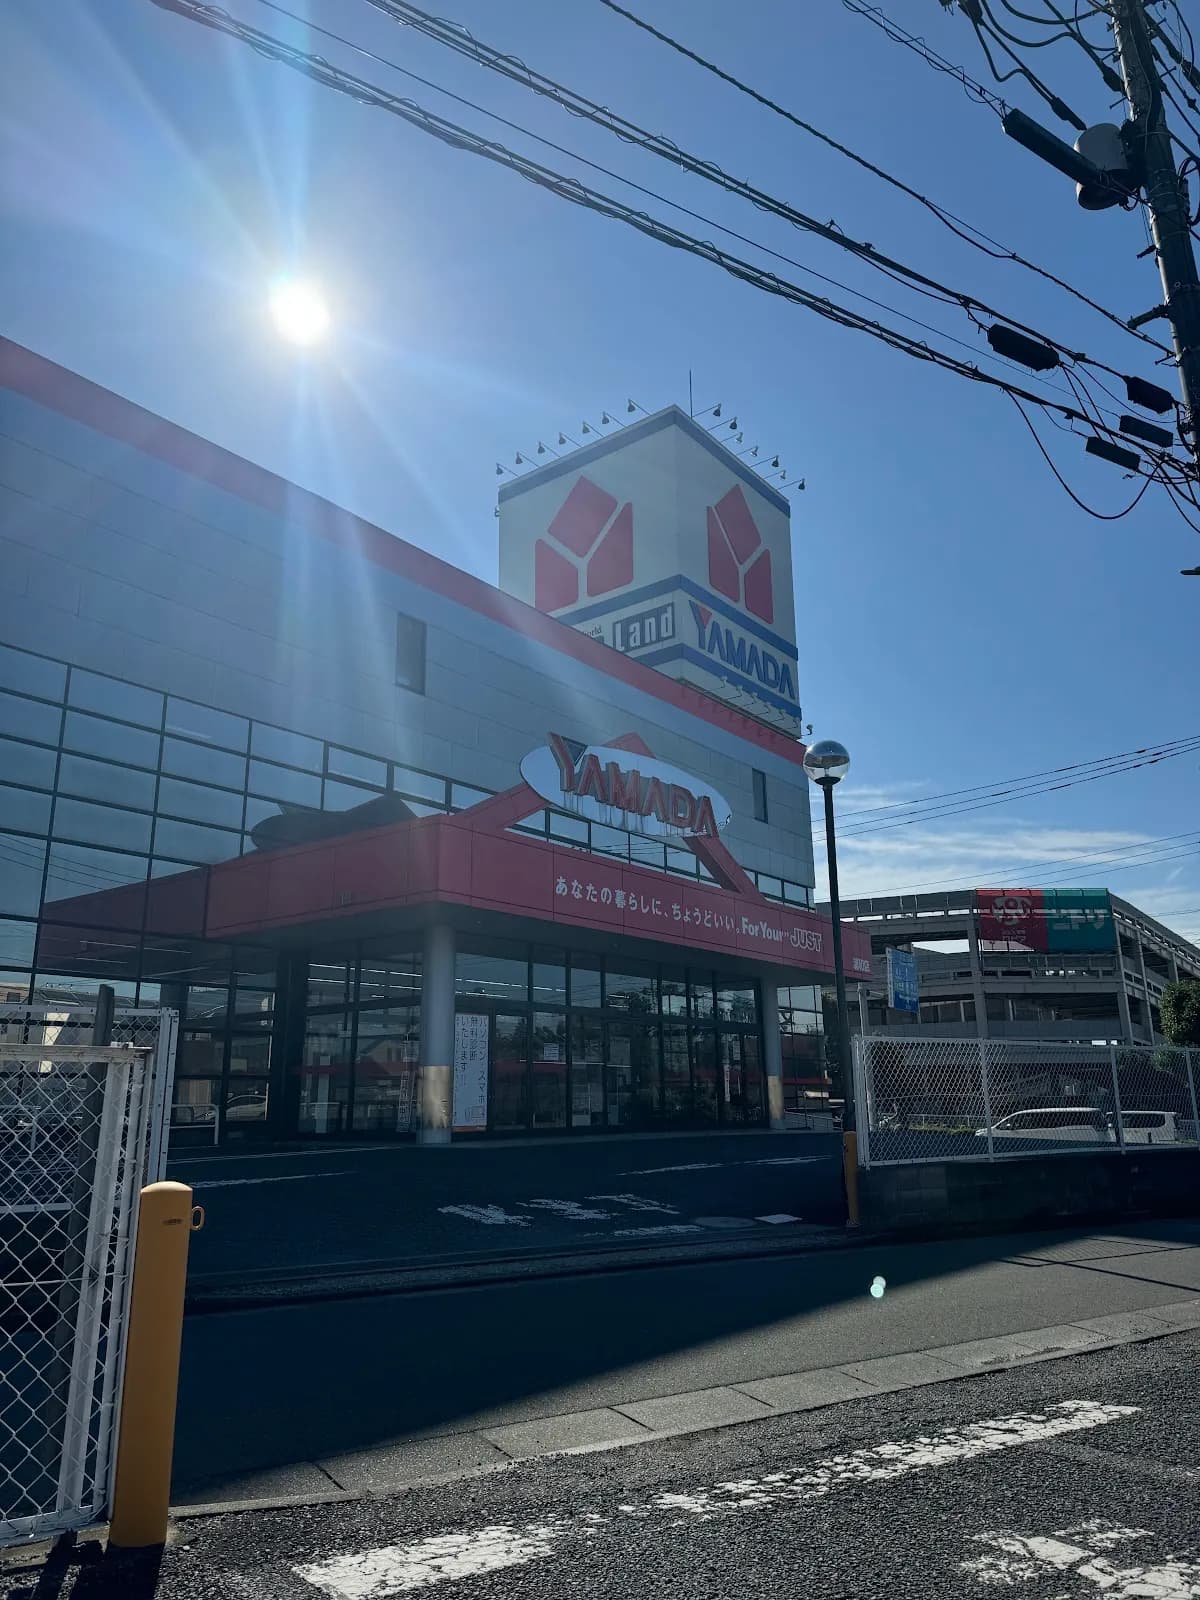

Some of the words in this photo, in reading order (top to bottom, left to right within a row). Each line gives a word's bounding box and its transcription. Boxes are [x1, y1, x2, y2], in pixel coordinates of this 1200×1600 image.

[615, 605, 673, 651] Land
[689, 600, 795, 699] YAMADA
[549, 732, 719, 838] YAMADA
[790, 927, 822, 952] JUST
